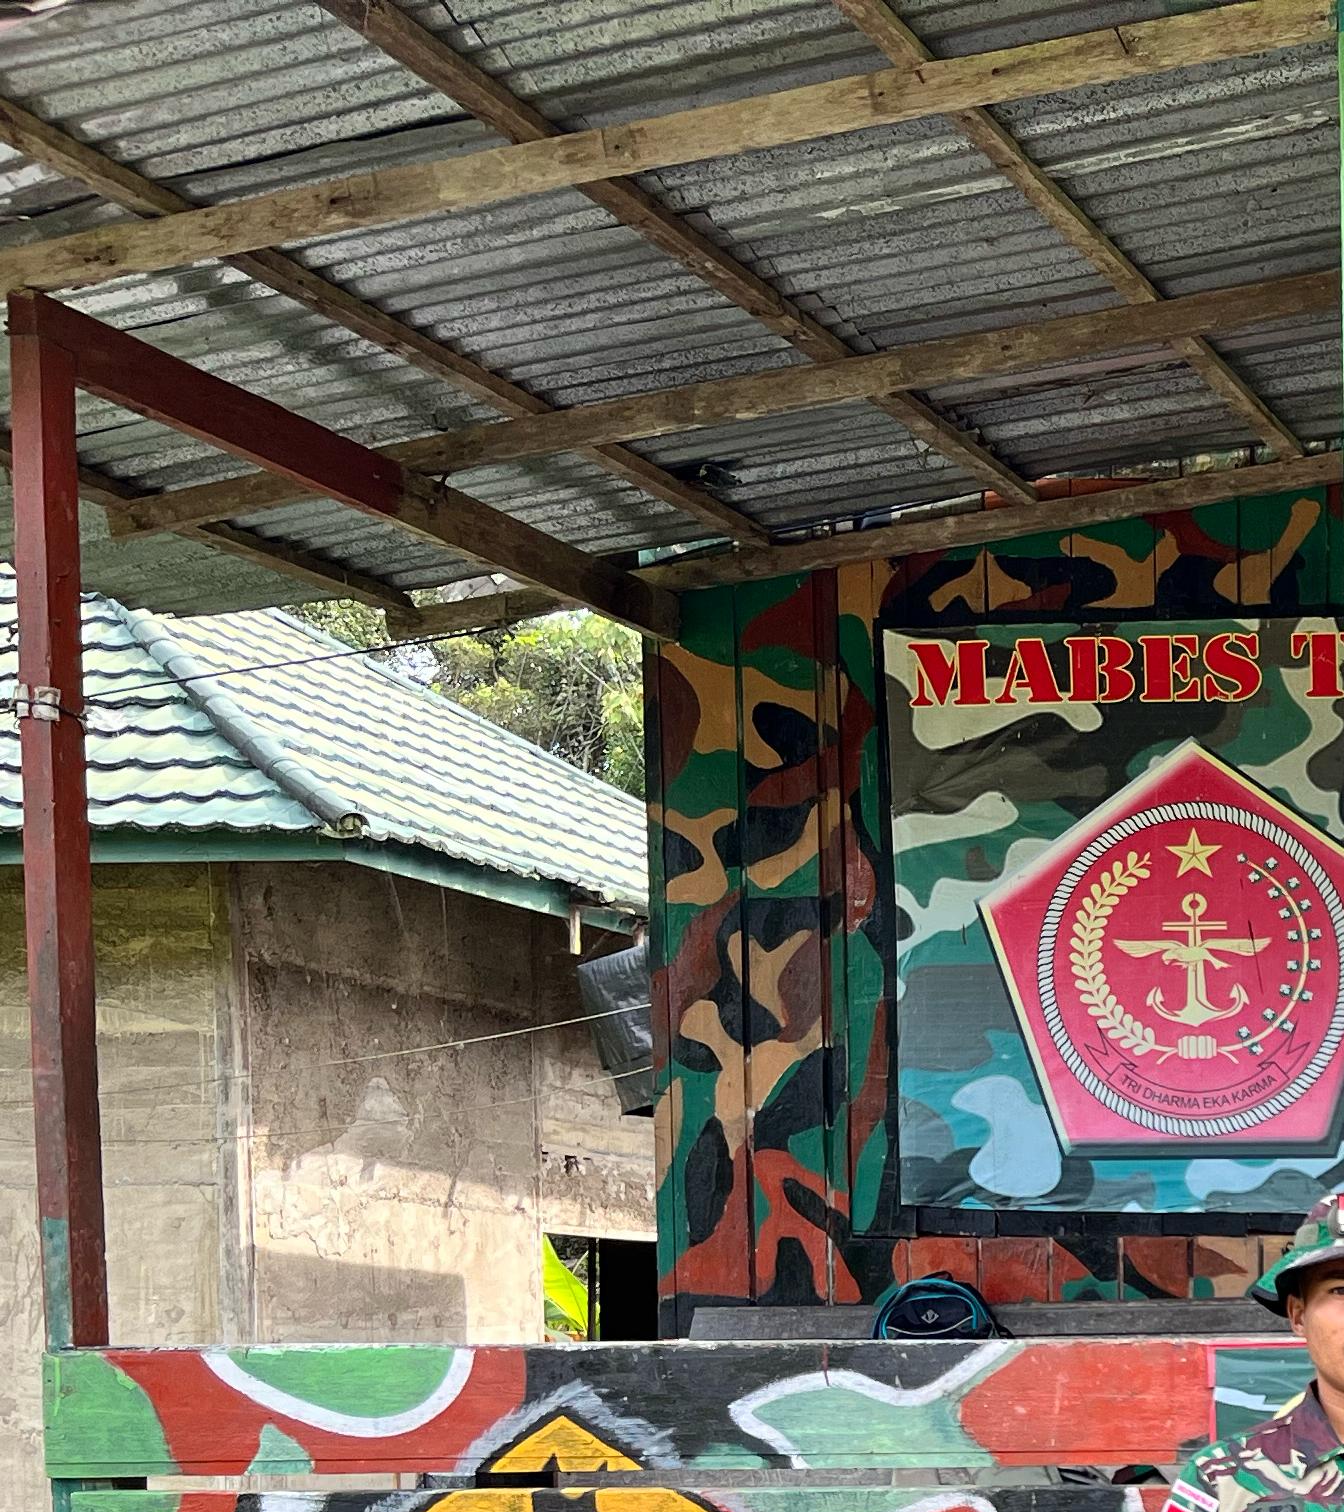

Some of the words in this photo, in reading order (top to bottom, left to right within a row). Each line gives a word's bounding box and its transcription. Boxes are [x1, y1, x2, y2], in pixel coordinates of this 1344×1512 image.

[908, 629, 1263, 708] MABES
[1120, 1073, 1142, 1095] TRI
[1142, 1087, 1201, 1110] DHARMA
[1203, 1094, 1231, 1110] EKA
[1231, 1074, 1279, 1104] KARMA
